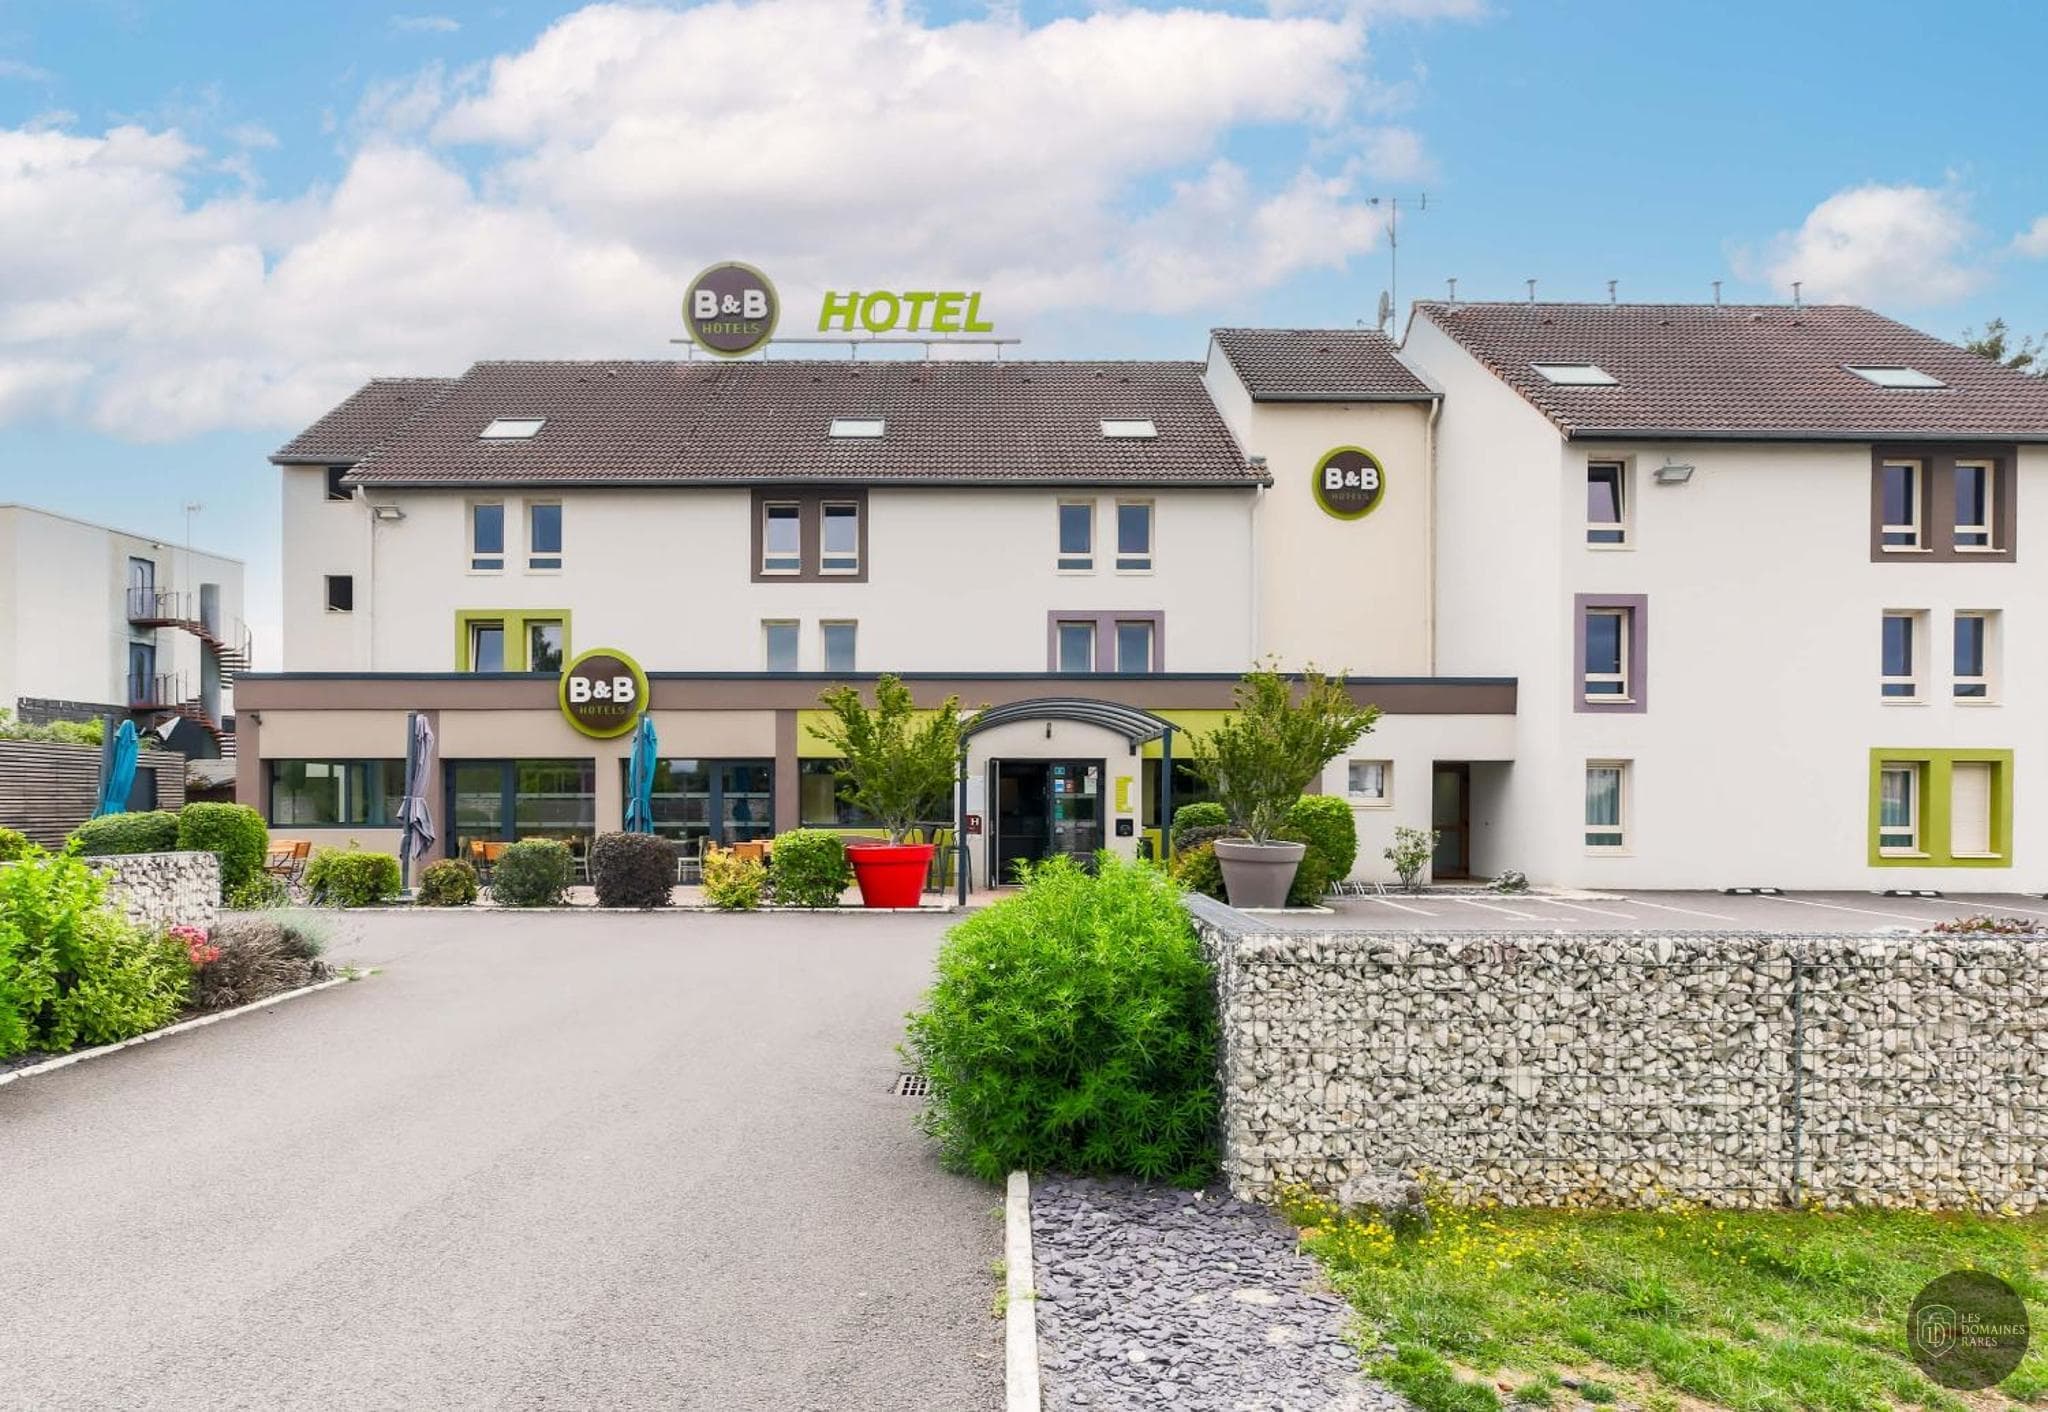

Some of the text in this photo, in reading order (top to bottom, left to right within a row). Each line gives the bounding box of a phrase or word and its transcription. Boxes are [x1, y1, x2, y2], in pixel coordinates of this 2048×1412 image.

[695, 290, 768, 319] B&B
[818, 290, 994, 333] HOTEL
[702, 322, 760, 334] HOTELS
[1325, 467, 1379, 490] B&B
[569, 676, 636, 703] B&B
[580, 704, 625, 715] HOTELS
